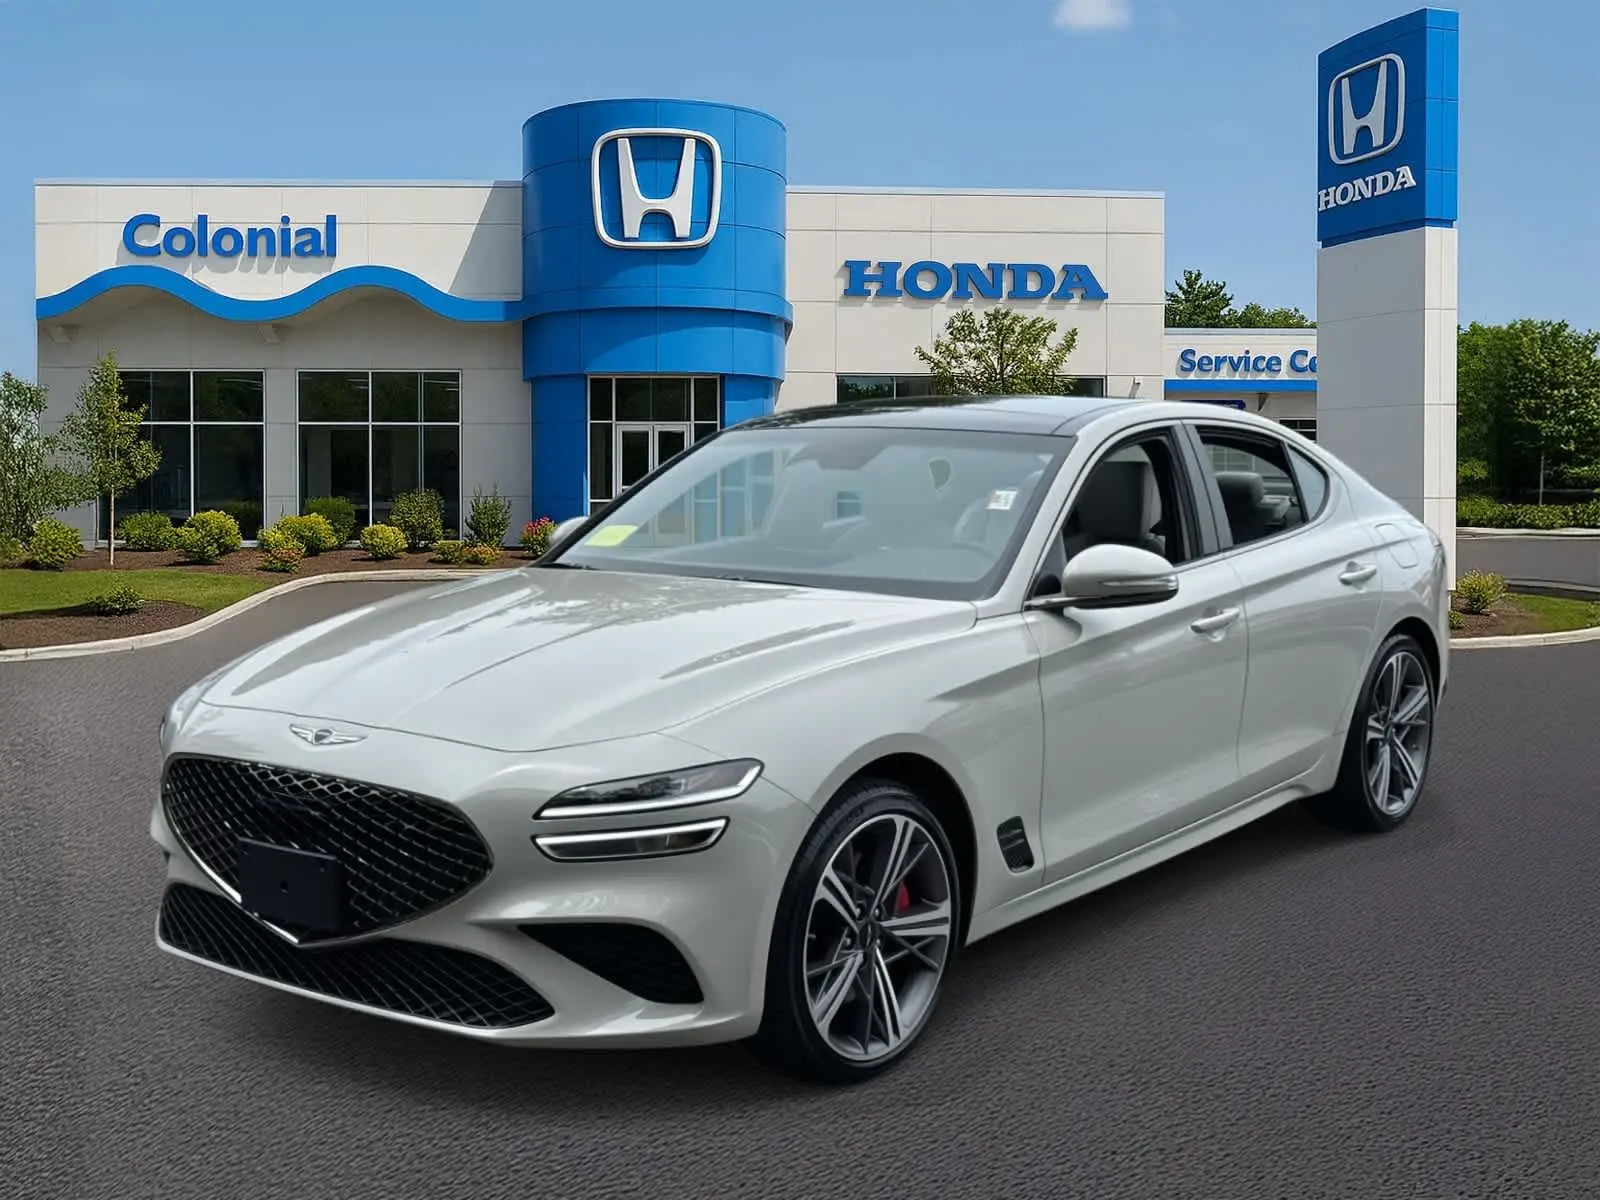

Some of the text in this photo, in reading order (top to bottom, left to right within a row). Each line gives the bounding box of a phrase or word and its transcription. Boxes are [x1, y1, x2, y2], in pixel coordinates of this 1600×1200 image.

[1318, 165, 1417, 212] HONDA
[122, 213, 337, 258] Colonial
[843, 260, 1109, 300] HONDA
[1180, 349, 1282, 373] Service
